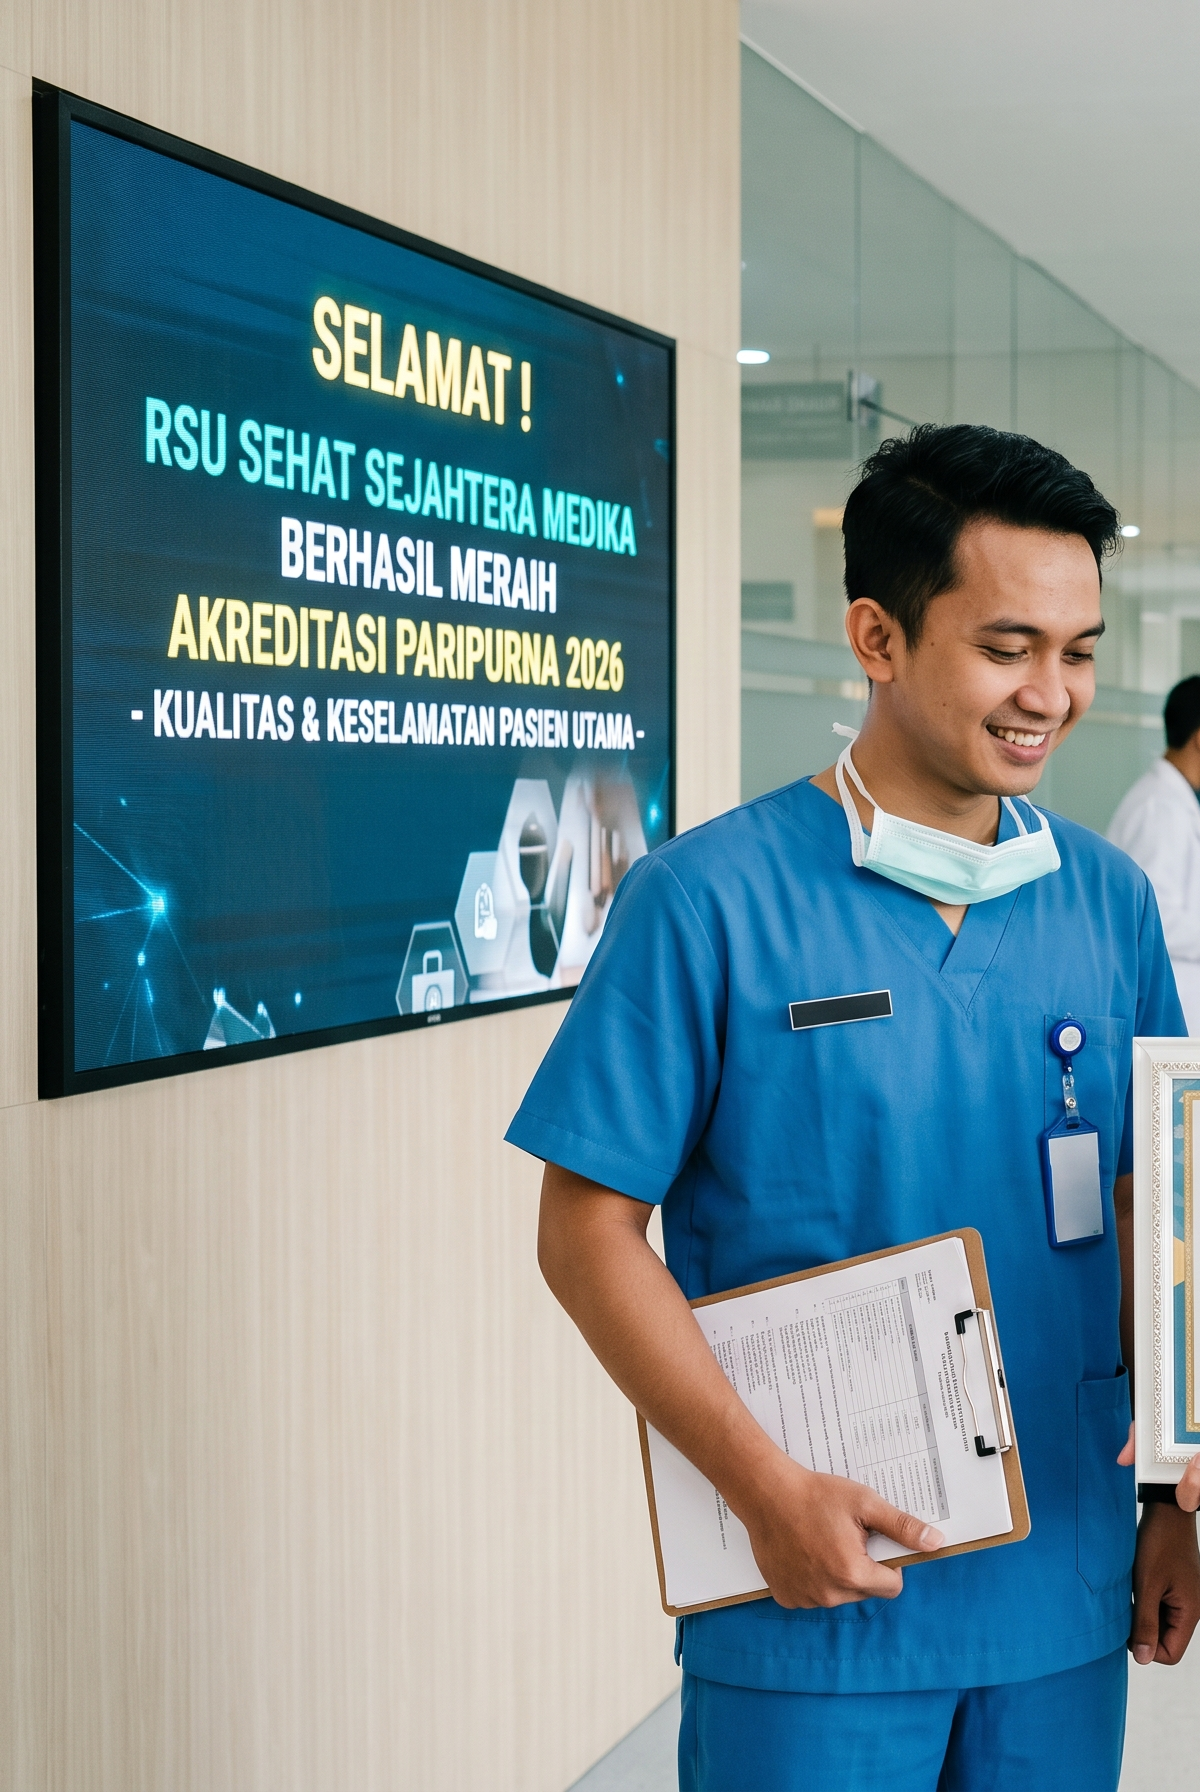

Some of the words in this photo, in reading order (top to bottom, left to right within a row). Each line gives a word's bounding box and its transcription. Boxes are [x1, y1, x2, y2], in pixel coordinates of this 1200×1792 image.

[312, 295, 512, 426] SELAMAT
[520, 361, 532, 433] !
[145, 396, 227, 477] RSU
[238, 419, 357, 501] SEHAT
[364, 447, 538, 538] SEJAHTERA
[542, 487, 637, 557] MEDIKA
[281, 516, 444, 599] BERHASIL
[450, 545, 557, 614] MERAIH
[167, 593, 387, 674] AKREDITASI
[396, 617, 561, 687] PARIPURNA
[565, 636, 624, 692] 2026
[153, 688, 295, 742] KUALITAS
[301, 696, 321, 742] &
[326, 697, 495, 747] KESELAMATAN
[499, 706, 569, 749] PASIEN
